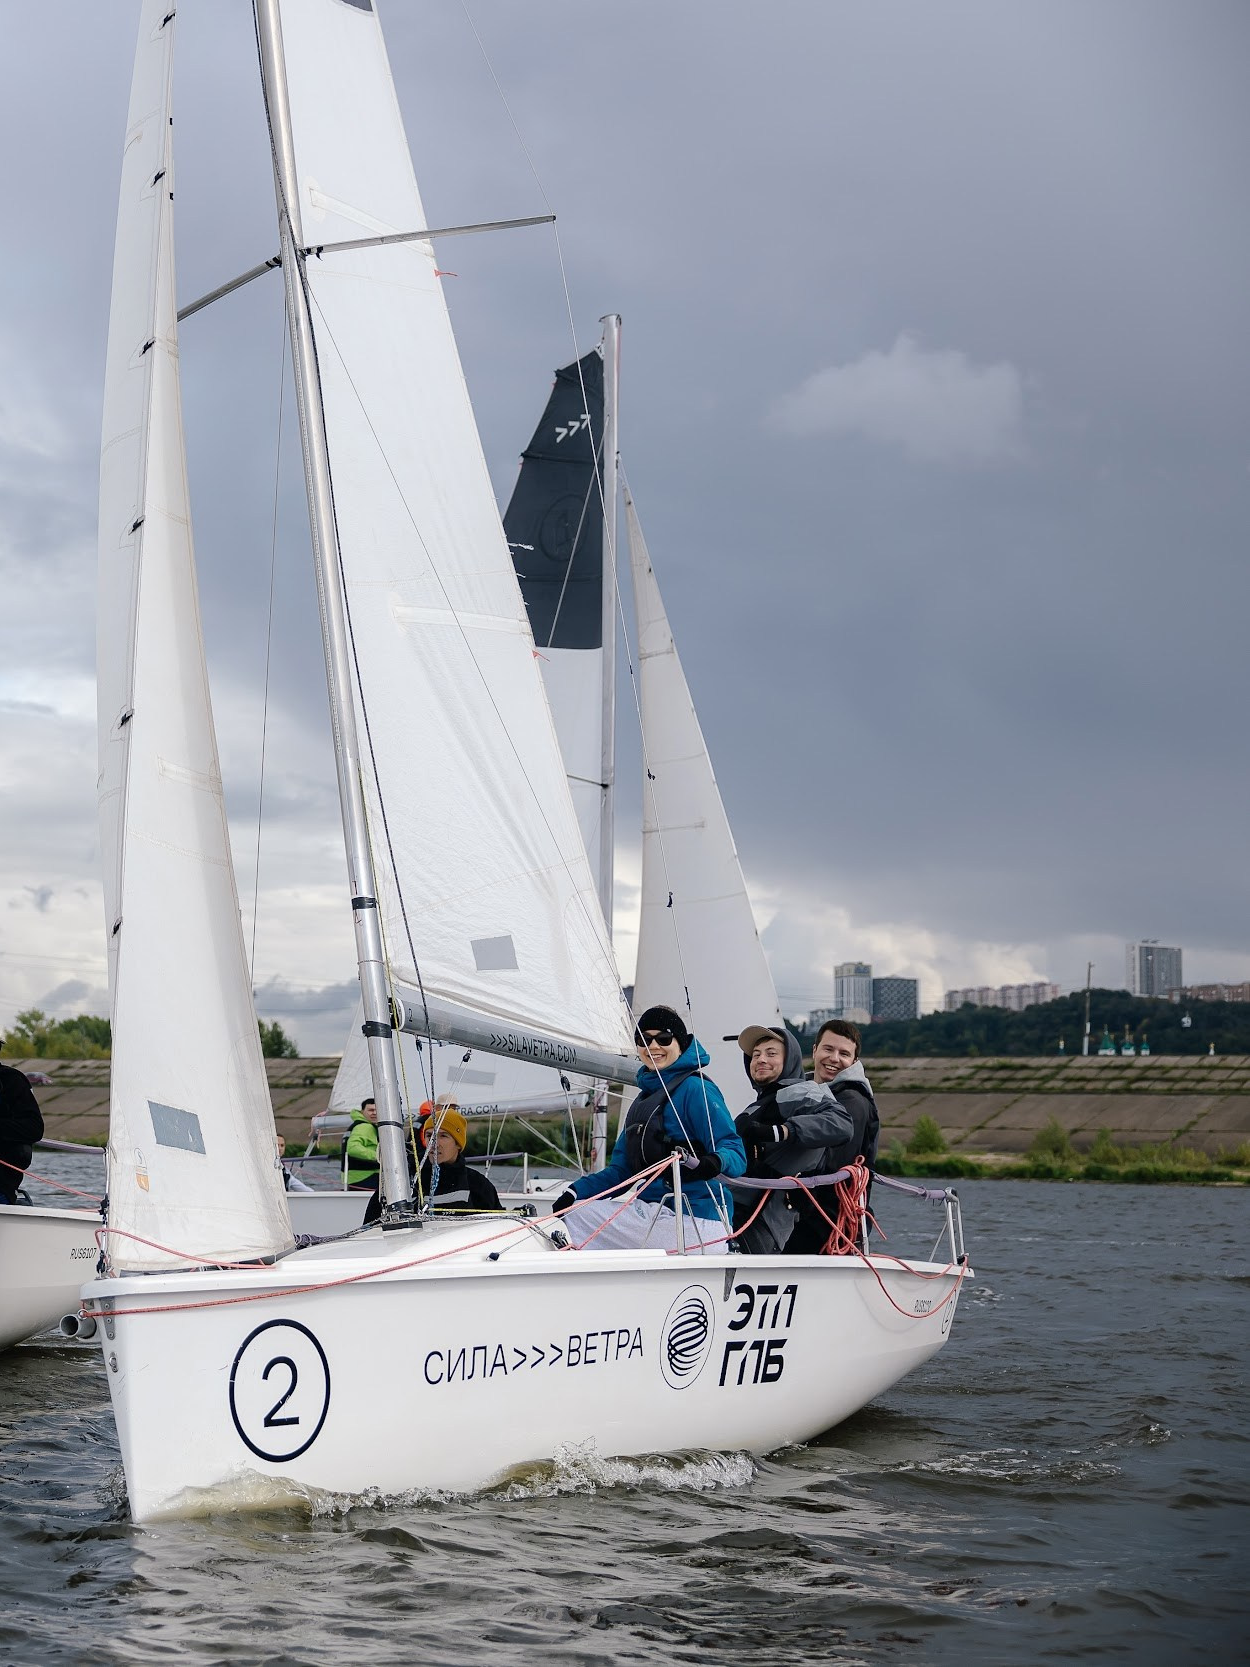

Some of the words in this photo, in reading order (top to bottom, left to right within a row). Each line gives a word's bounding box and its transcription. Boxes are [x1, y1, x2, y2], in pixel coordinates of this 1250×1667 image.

[408, 1008, 413, 1022] 2
[727, 1284, 798, 1331] ЭТП
[718, 1338, 788, 1387] ГПБ
[261, 1355, 300, 1428] 2
